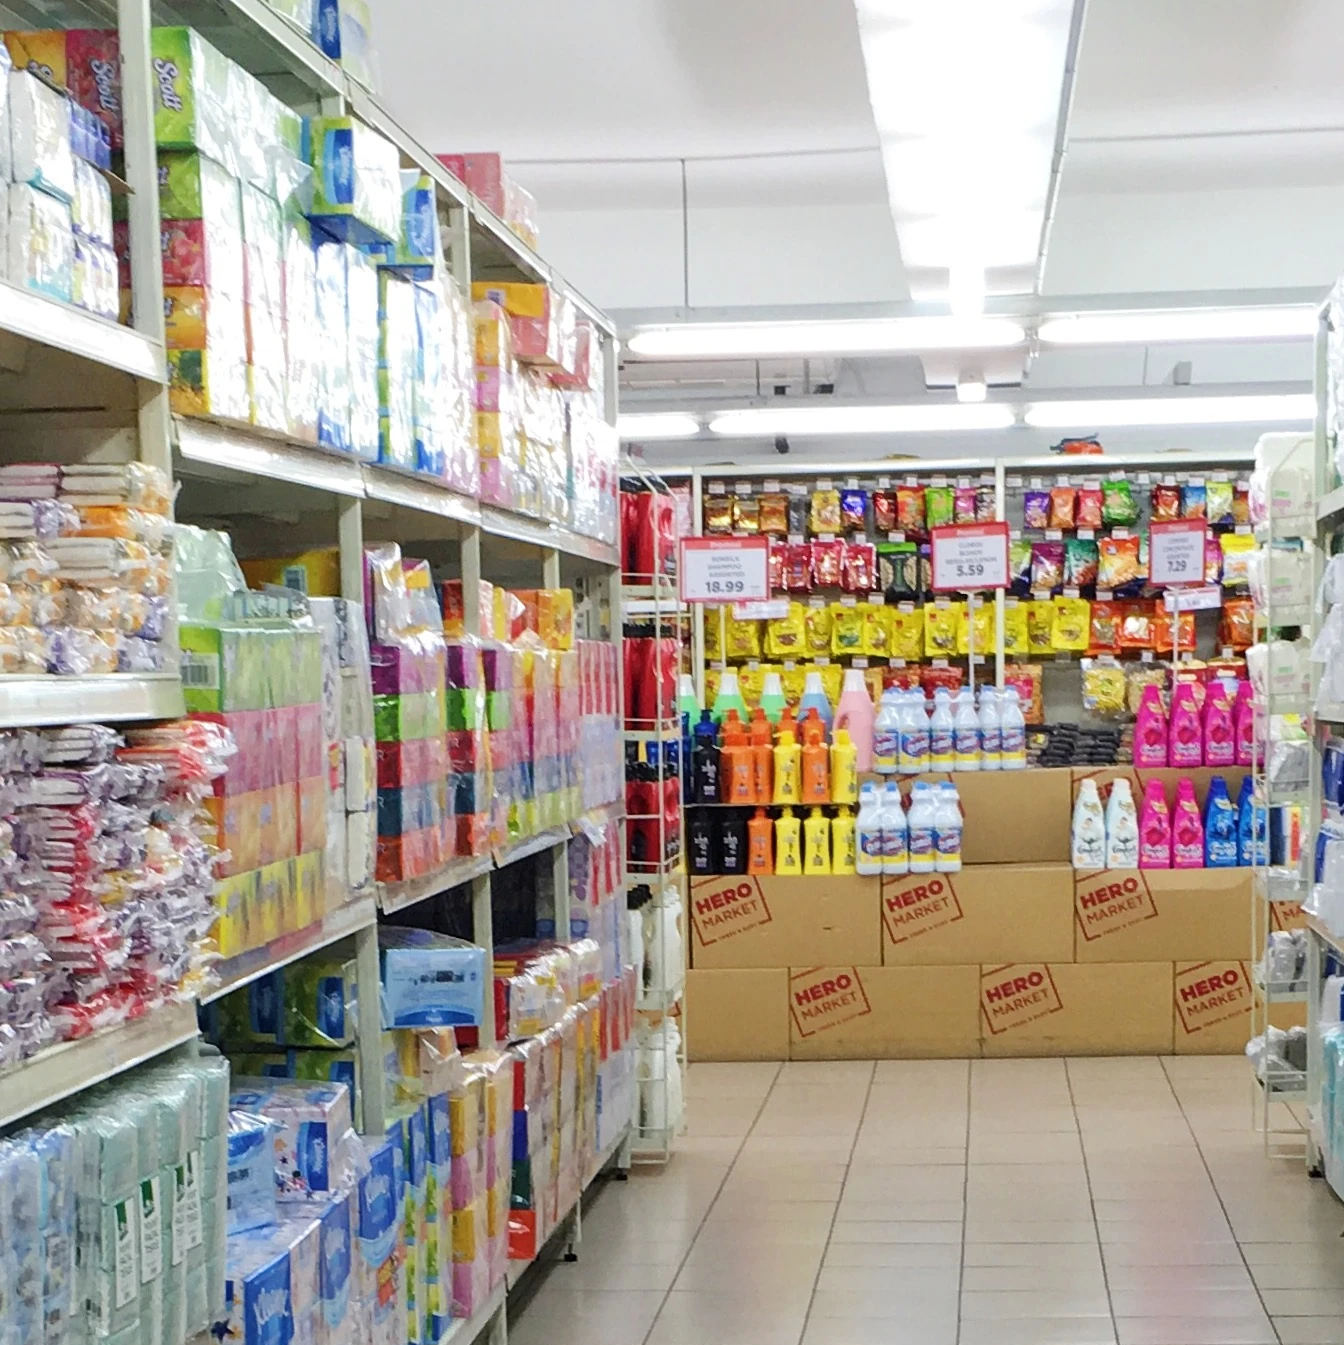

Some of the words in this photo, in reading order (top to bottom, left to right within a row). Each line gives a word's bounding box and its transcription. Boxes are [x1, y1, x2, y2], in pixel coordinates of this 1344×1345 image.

[90, 58, 121, 113] Scott
[152, 57, 184, 112] Scott
[956, 564, 984, 577] 5.59
[705, 581, 745, 594] 18.99
[695, 882, 753, 915] HERO
[885, 879, 944, 913] HERO
[1079, 877, 1139, 908] HERO
[701, 900, 758, 930] MARKET
[892, 896, 949, 928] MARKET
[1086, 894, 1144, 925] MARKET
[794, 974, 852, 1006] HERO
[985, 971, 1044, 1003] HERO
[1179, 969, 1238, 1001] HERO
[800, 991, 857, 1022] MARKET
[992, 988, 1049, 1018] MARKET
[1186, 986, 1244, 1017] MARKET
